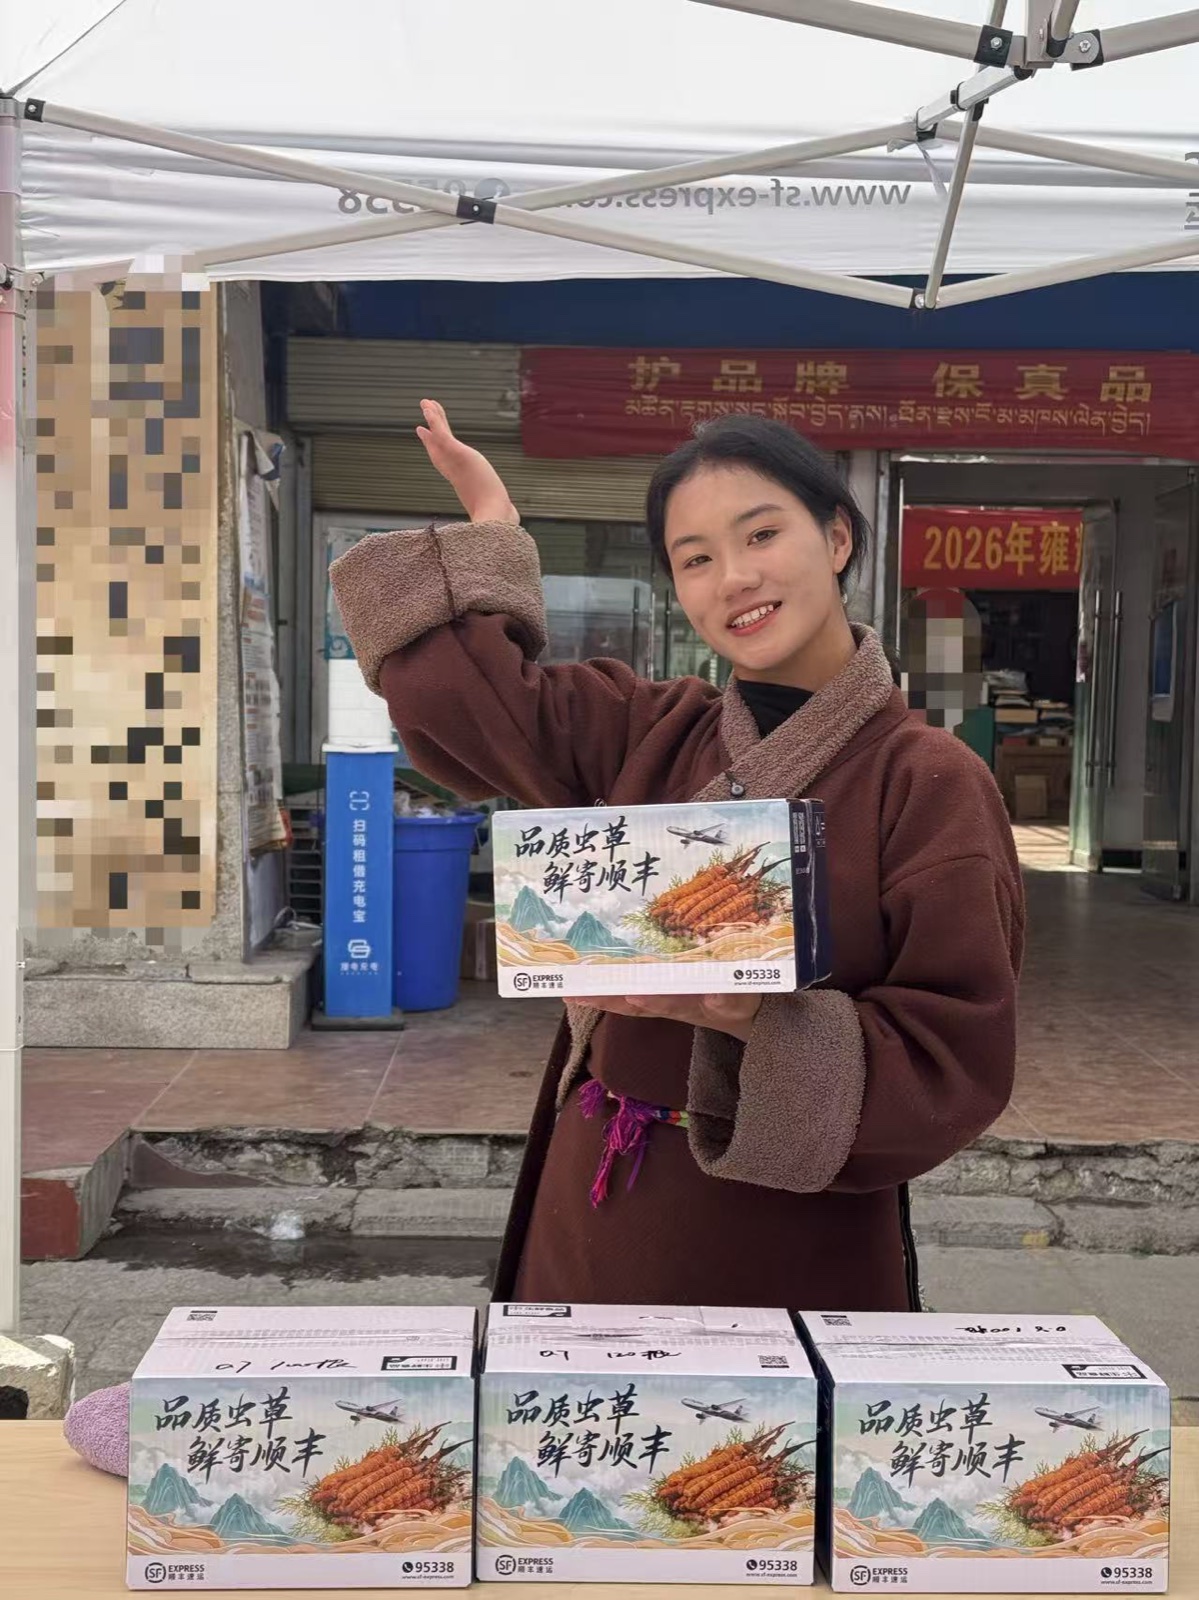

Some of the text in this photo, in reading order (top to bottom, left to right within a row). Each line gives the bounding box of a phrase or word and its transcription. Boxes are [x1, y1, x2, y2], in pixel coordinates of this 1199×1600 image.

[628, 356, 1152, 402] 护品牌 保真品
[923, 521, 1083, 576] 2026年雍
[514, 815, 632, 863] 品质虫草
[352, 818, 367, 923] 扫码租借充电宝
[542, 851, 661, 903] 鲜寄顺丰
[532, 973, 564, 982] EXPRESS
[745, 969, 781, 980] 95338
[155, 1386, 293, 1439] 品质虫草
[507, 1382, 640, 1436] 品质虫草
[859, 1393, 993, 1445] 品质虫草
[186, 1427, 326, 1484] 鲜寄顺丰
[536, 1425, 673, 1478] 鲜寄顺丰
[890, 1433, 1026, 1488] 鲜寄顺丰
[168, 1564, 205, 1573] EXPRESS
[415, 1561, 454, 1573] 95338
[518, 1557, 554, 1566] EXPRESS
[759, 1559, 798, 1571] 95338
[872, 1567, 908, 1576] EXPRESS
[1114, 1567, 1153, 1578] 95338
